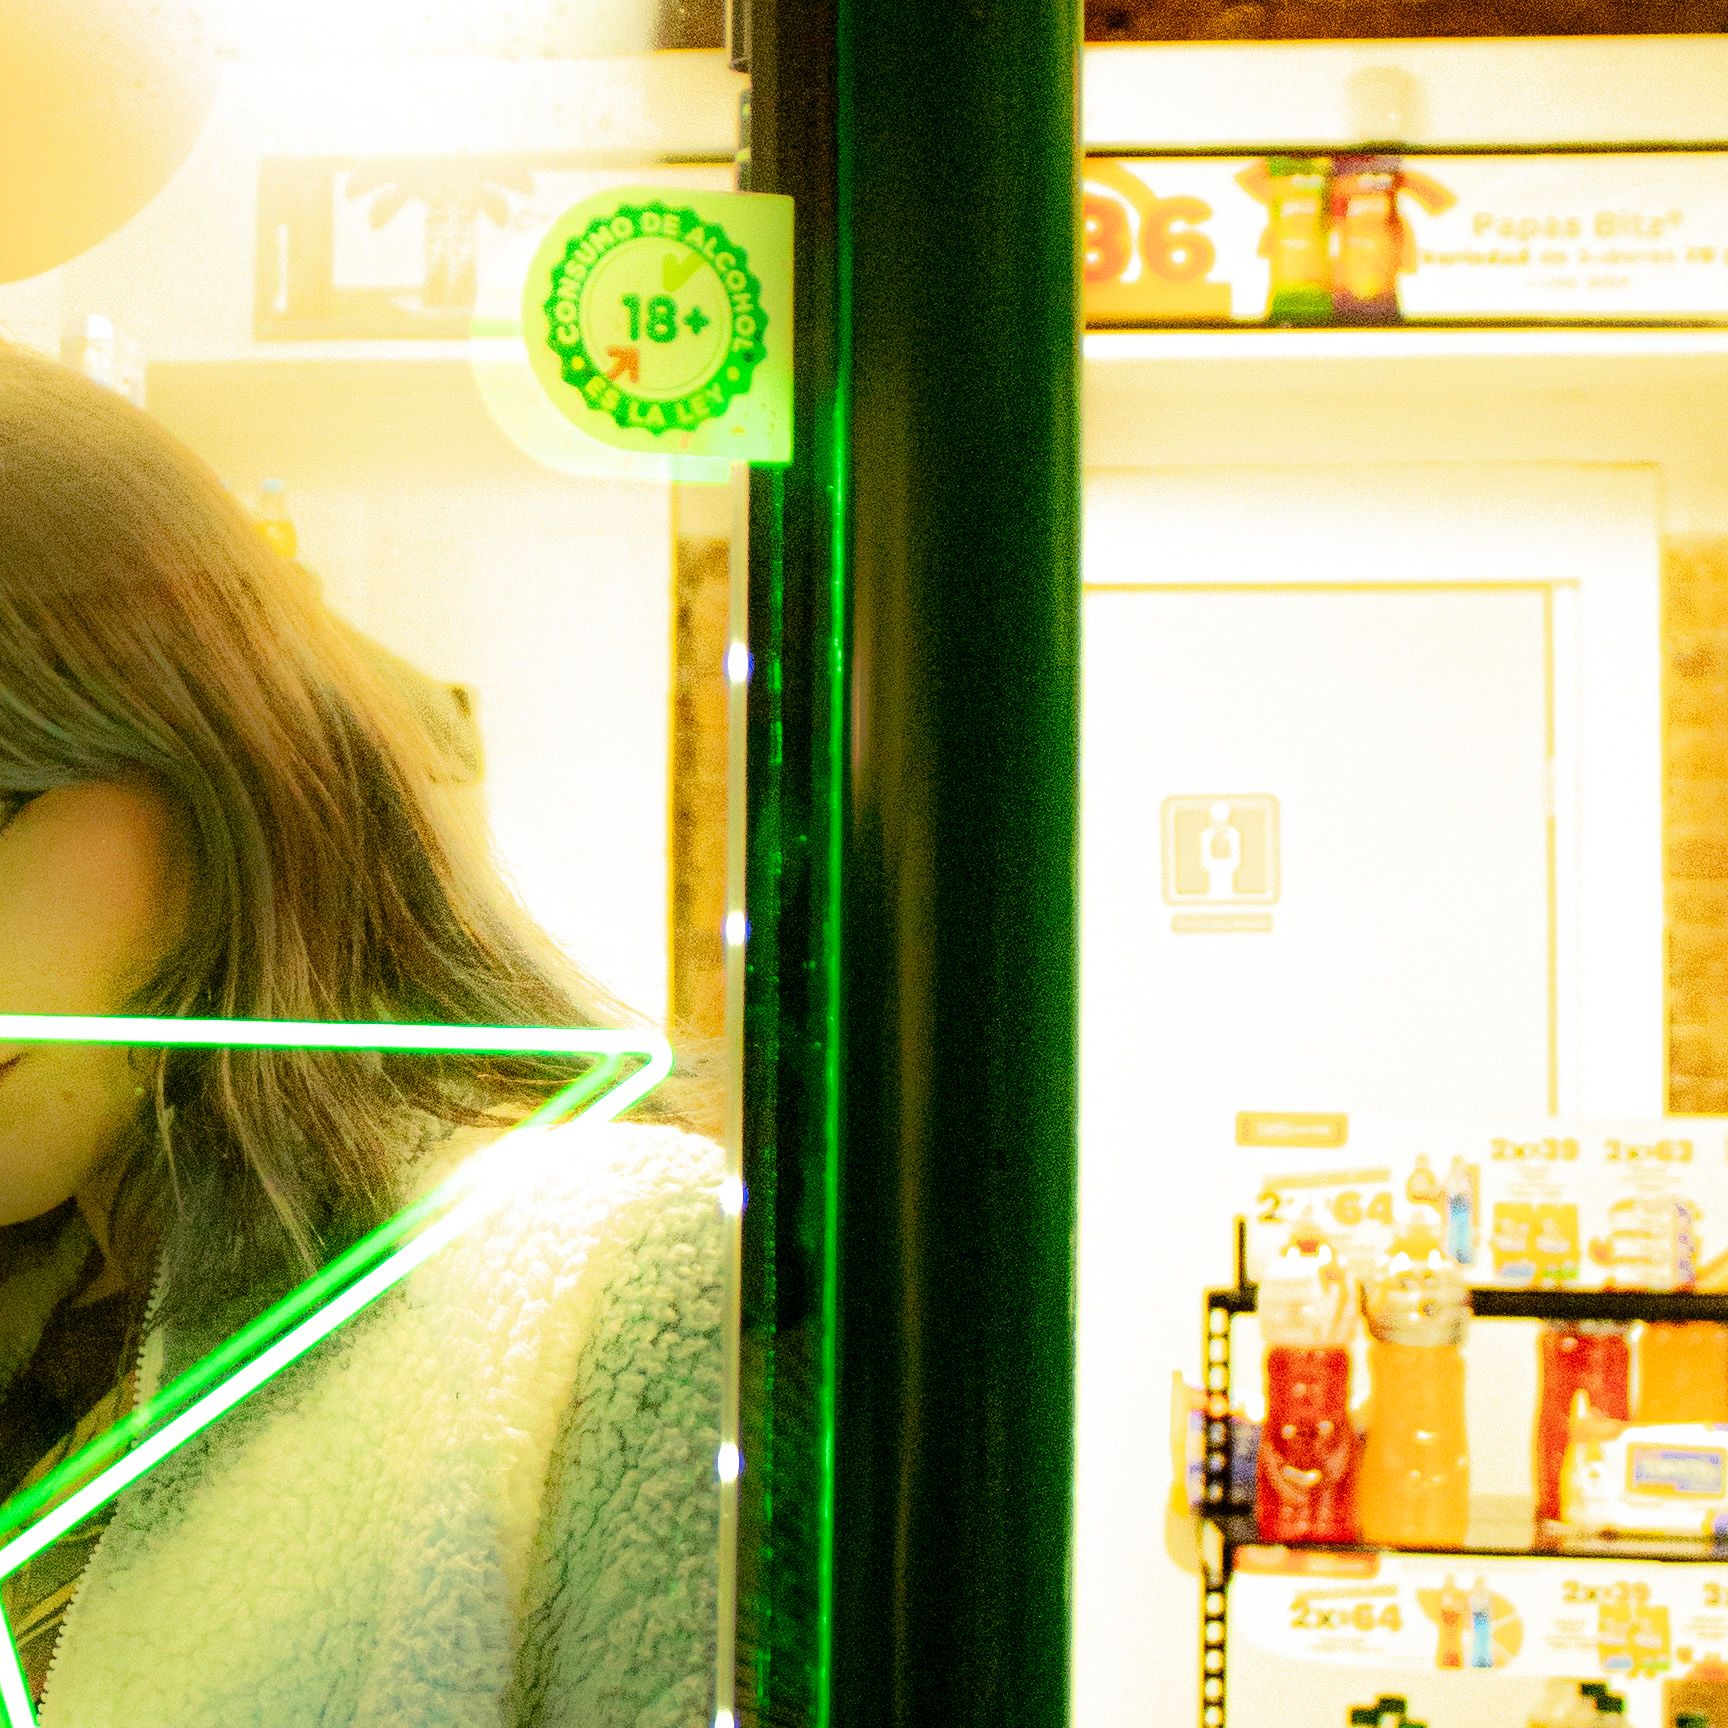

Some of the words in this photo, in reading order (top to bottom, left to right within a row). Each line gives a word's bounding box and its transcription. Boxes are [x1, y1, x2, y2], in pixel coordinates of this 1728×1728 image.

[555, 215, 635, 346] CONSUMO
[639, 210, 682, 238] DE
[683, 225, 758, 352] ALCOHOL
[621, 292, 711, 344] 18+
[627, 400, 666, 426] LA
[675, 381, 725, 422] LEY
